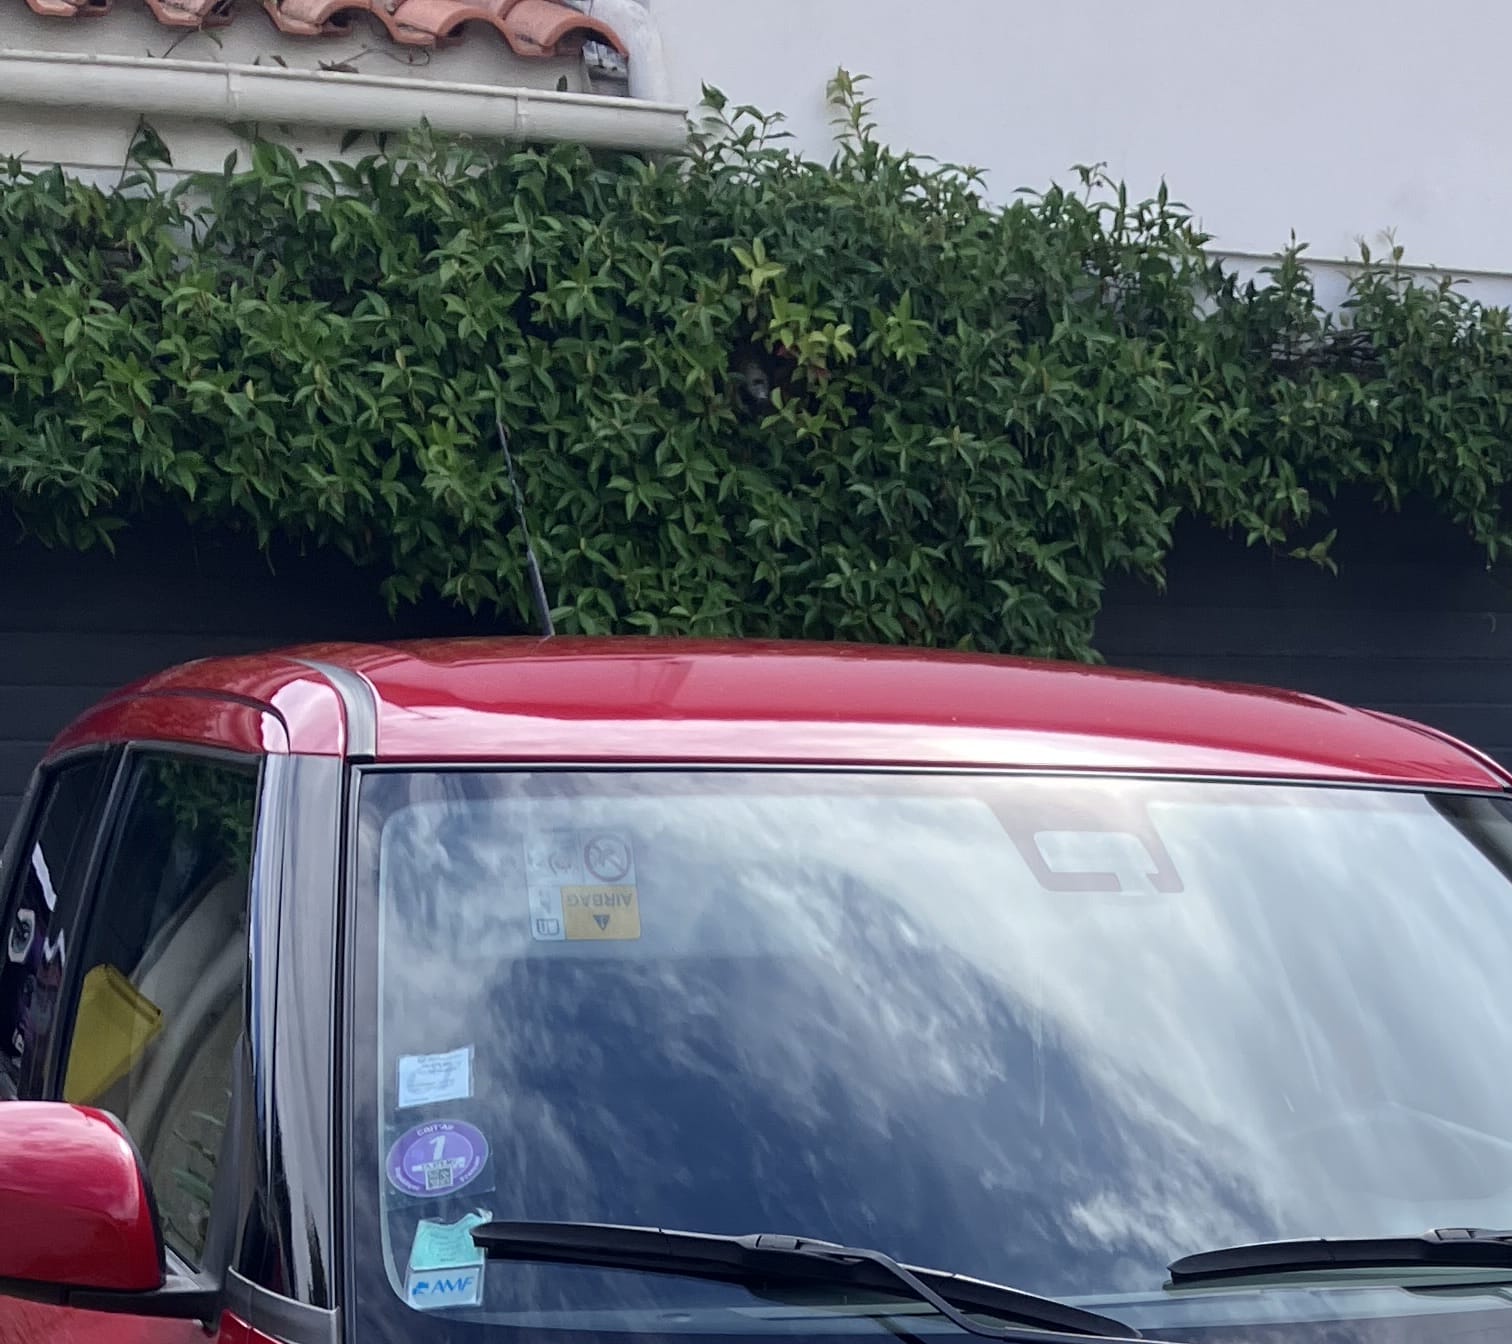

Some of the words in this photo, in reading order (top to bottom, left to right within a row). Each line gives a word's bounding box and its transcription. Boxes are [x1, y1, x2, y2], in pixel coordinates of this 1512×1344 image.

[566, 893, 632, 907] AIRBAG
[429, 1135, 446, 1160] 1
[431, 1276, 474, 1294] AMF
